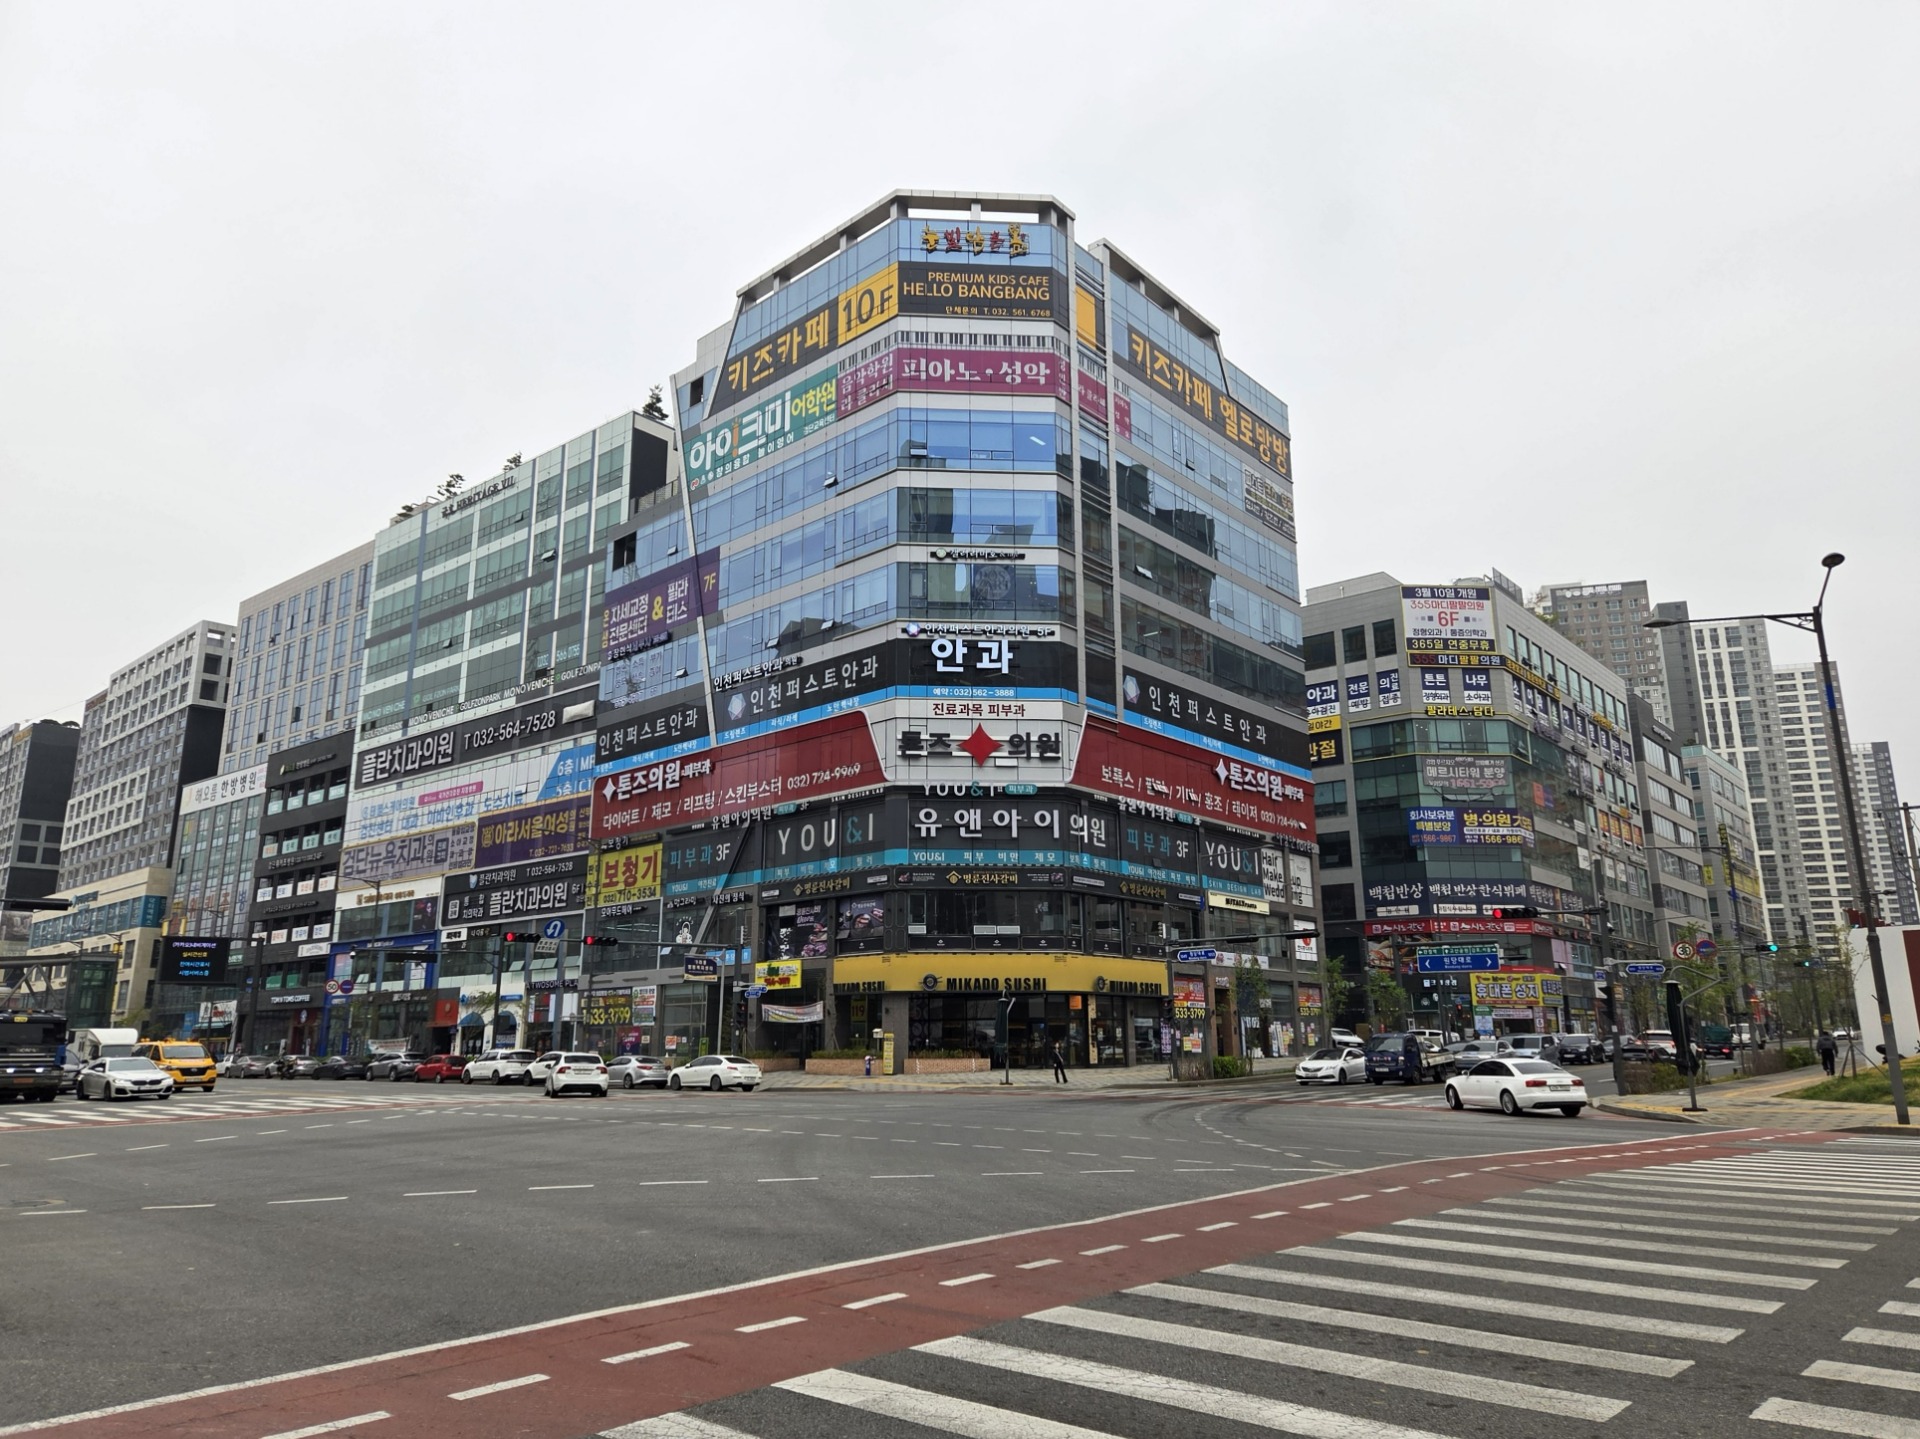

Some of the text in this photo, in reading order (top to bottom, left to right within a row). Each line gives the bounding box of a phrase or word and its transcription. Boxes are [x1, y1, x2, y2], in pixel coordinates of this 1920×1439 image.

[928, 272, 1049, 287] PREMIUM KIDS CAFE
[903, 282, 1050, 301] HELLO BANGBANG
[728, 309, 829, 392] 키즈카페
[841, 352, 893, 393] 음악학원
[791, 377, 837, 419] 어학원
[1131, 332, 1289, 474] 키즈카페 헬로방방
[704, 572, 717, 593] 7F
[1415, 587, 1477, 599] 3월 10일 개원
[610, 593, 664, 624] 자세교정 &
[666, 600, 688, 625] 테스
[1437, 611, 1460, 627] 6F
[609, 614, 648, 647] 전문센터
[1411, 628, 1488, 638] 정형외과 통증의학과
[1411, 638, 1490, 651] 365일 연중무휴
[931, 638, 1014, 675] 안과
[503, 686, 526, 699] MONO
[526, 675, 555, 692] VENICHE
[750, 653, 879, 716] 인천퍼스트안과
[1423, 673, 1488, 687] 튼튼 나무
[1306, 684, 1337, 703] 아과
[1348, 681, 1369, 696] 전문
[1465, 692, 1490, 702] 소아과
[933, 703, 1027, 718] 진료과목 피부과
[1148, 684, 1268, 746] 인천퍼스트안과
[598, 706, 699, 757] 인천퍼스트안과
[361, 731, 455, 784] 플란치과의원
[463, 733, 471, 750] T
[472, 709, 556, 748] 032-564-7528
[1007, 732, 1061, 760] 의원
[557, 758, 574, 776] 6층
[1426, 766, 1506, 779] 메르시타워 분양
[220, 770, 258, 799] 한방병원
[616, 760, 681, 801] 톤즈의원
[1008, 784, 1034, 795] 피부과
[1229, 760, 1284, 802] 톤즈의원
[603, 808, 641, 831] 다이어트
[652, 801, 671, 820] 제모
[683, 790, 715, 814] 리프팅
[725, 777, 783, 806] 스킨부스터
[786, 775, 810, 793] 032)
[811, 762, 861, 785] 724-9969
[1101, 764, 1135, 790] 보톡스
[1232, 799, 1259, 823] 레이저
[1409, 810, 1455, 821] 회사보유분
[495, 812, 569, 846] 아라서울여성
[1126, 829, 1190, 859] 피부과 3F
[342, 835, 427, 877] 검단뉴욕치과
[670, 843, 731, 870] 피부과 3F
[913, 852, 1057, 862] YOU&I 피부 비만 제모
[1262, 851, 1278, 867] Hair
[478, 868, 518, 887] 플란치과의원
[602, 850, 658, 889] 보청기
[962, 871, 1019, 885] 명륜진사갈비
[1262, 867, 1284, 882] Make
[617, 886, 657, 901] 710-3534
[1208, 880, 1223, 890] SKIN
[1227, 884, 1248, 894] DESIGN
[489, 880, 568, 918] 플란치과의원
[1443, 956, 1473, 965] 원당대로
[327, 983, 338, 991] 50
[532, 980, 563, 989] TWOSOME
[946, 977, 1047, 991] MIKADO SUSHI
[1475, 983, 1513, 999] 휴대폰
[1514, 983, 1540, 999] 성지
